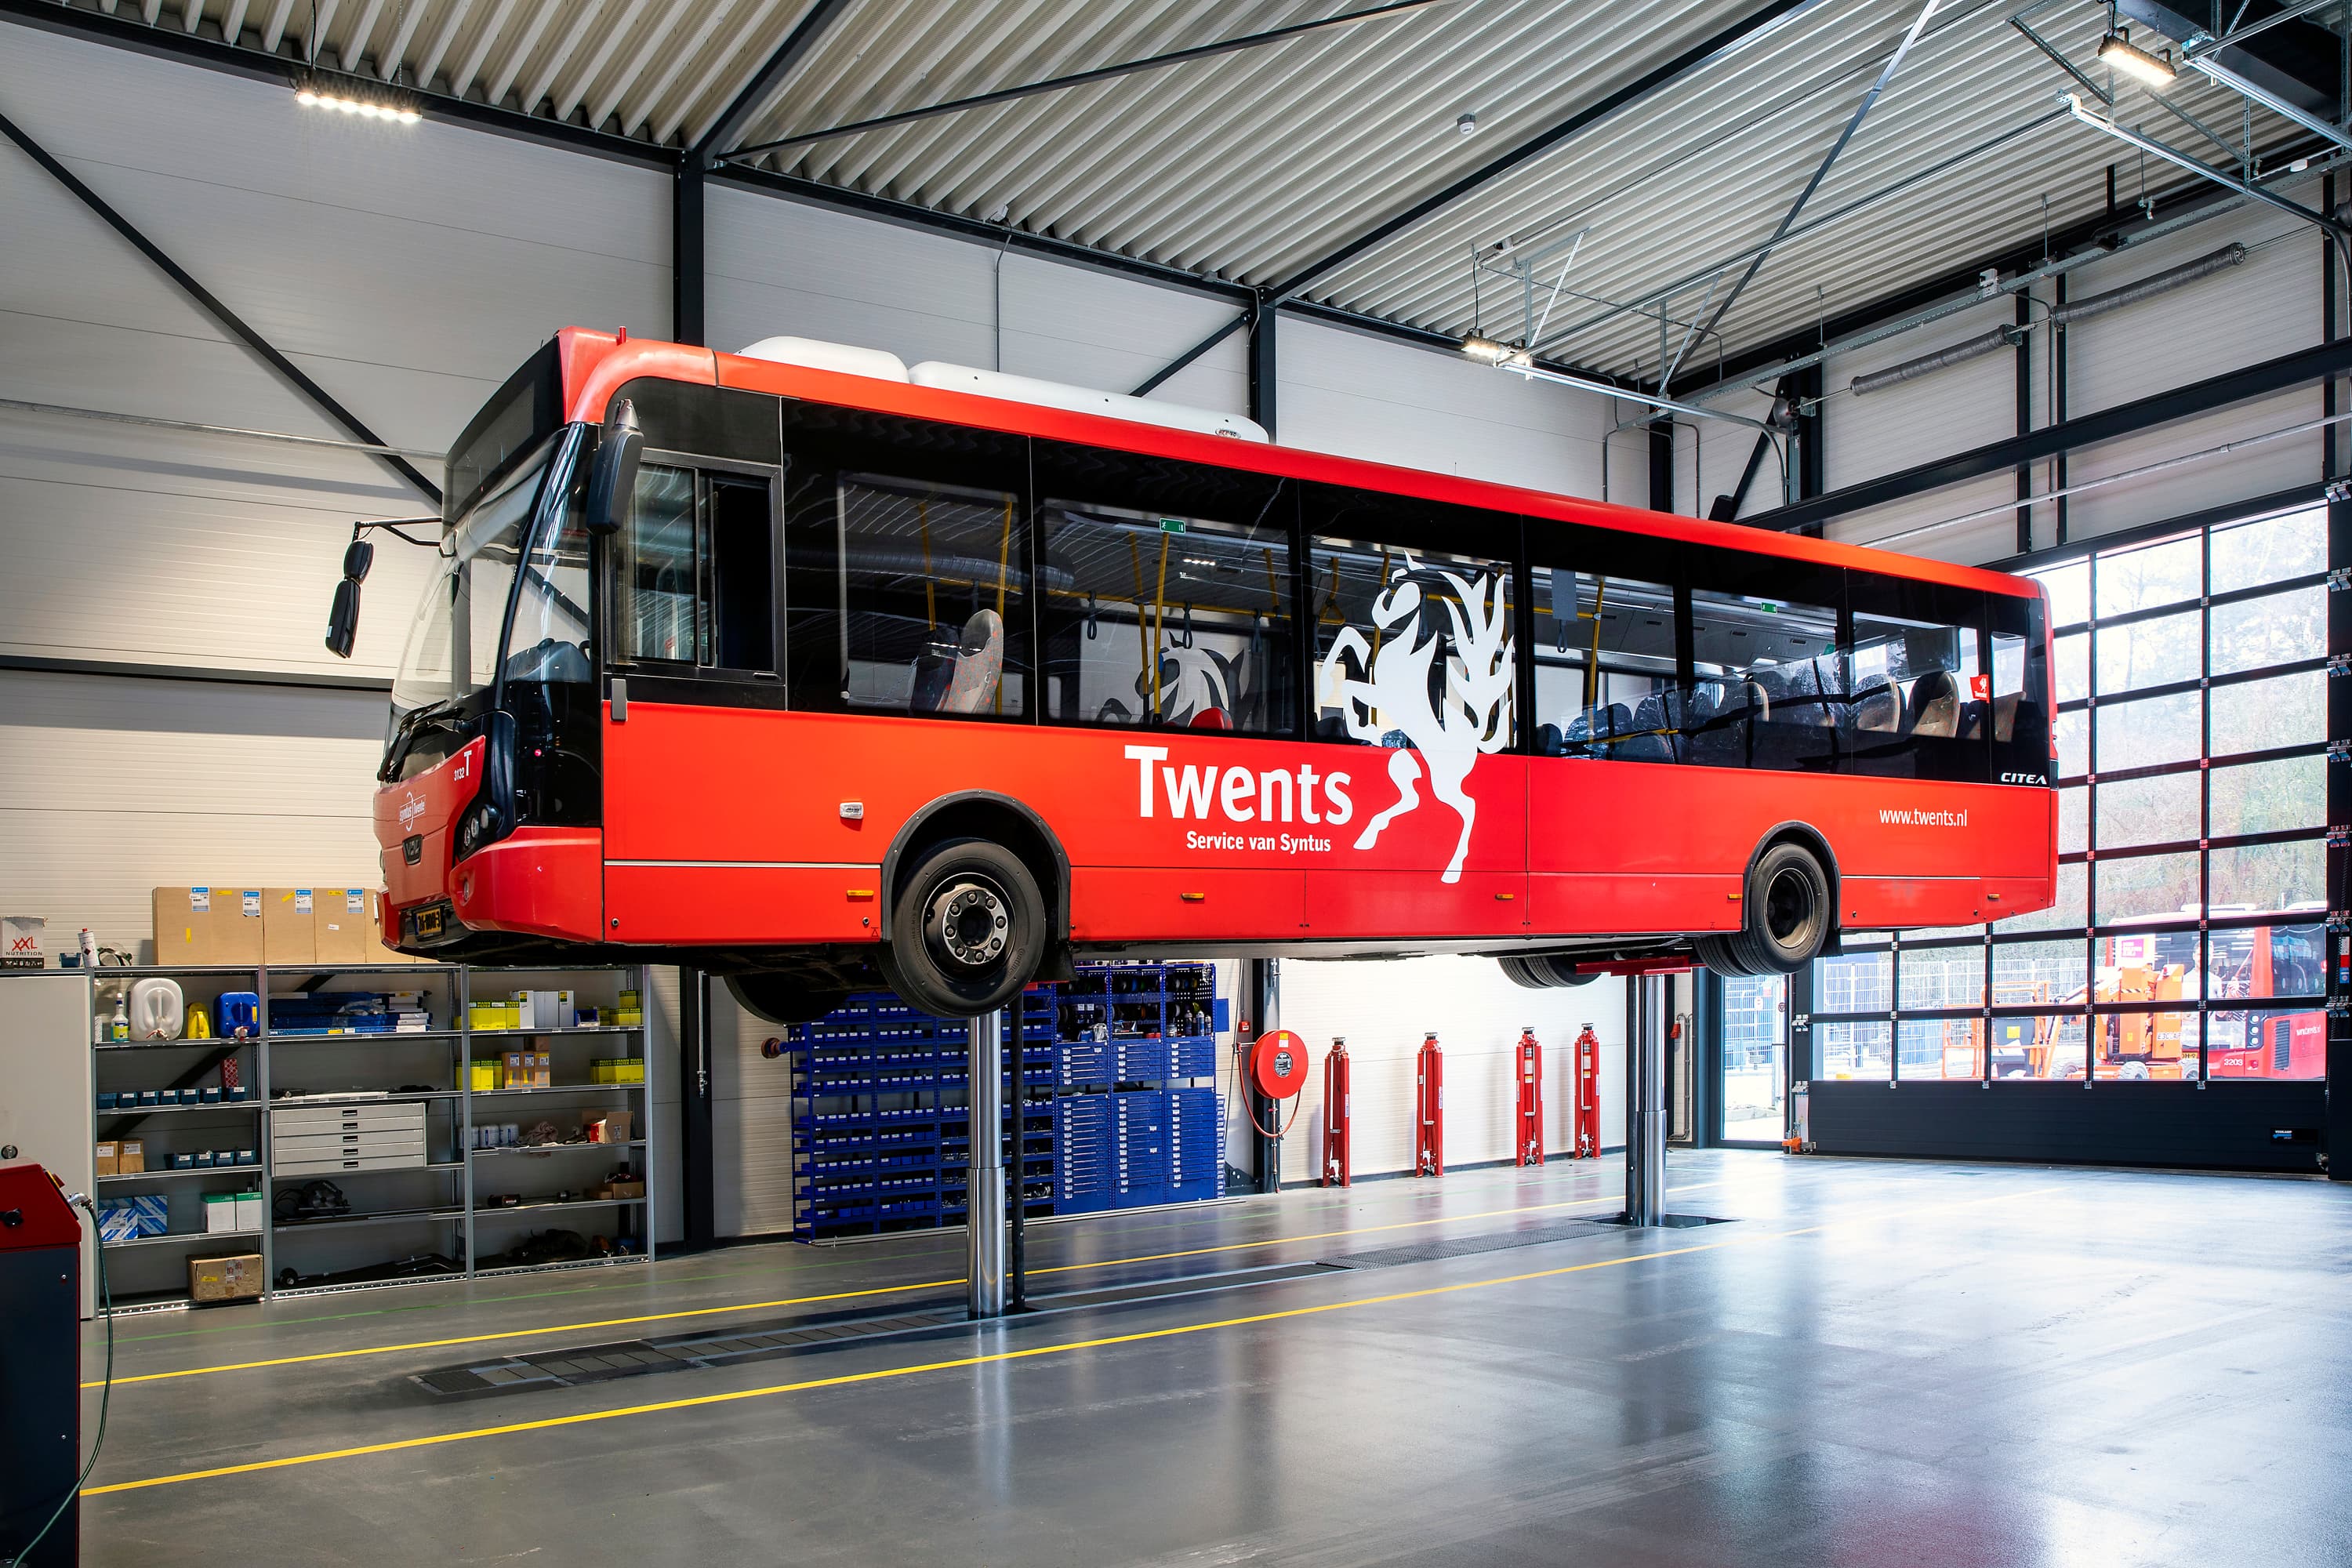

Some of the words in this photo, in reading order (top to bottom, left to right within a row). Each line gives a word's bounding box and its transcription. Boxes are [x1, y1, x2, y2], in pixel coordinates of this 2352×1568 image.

[463, 750, 472, 776] T
[1124, 745, 1353, 826] Twents
[2001, 772, 2047, 785] CITEA
[1879, 808, 1968, 827] www.twents.nl
[1186, 830, 1244, 850] Service
[1249, 836, 1276, 851] van
[1279, 833, 1331, 854] Syntus
[12, 936, 38, 952] XXL
[2223, 1058, 2244, 1067] 3203
